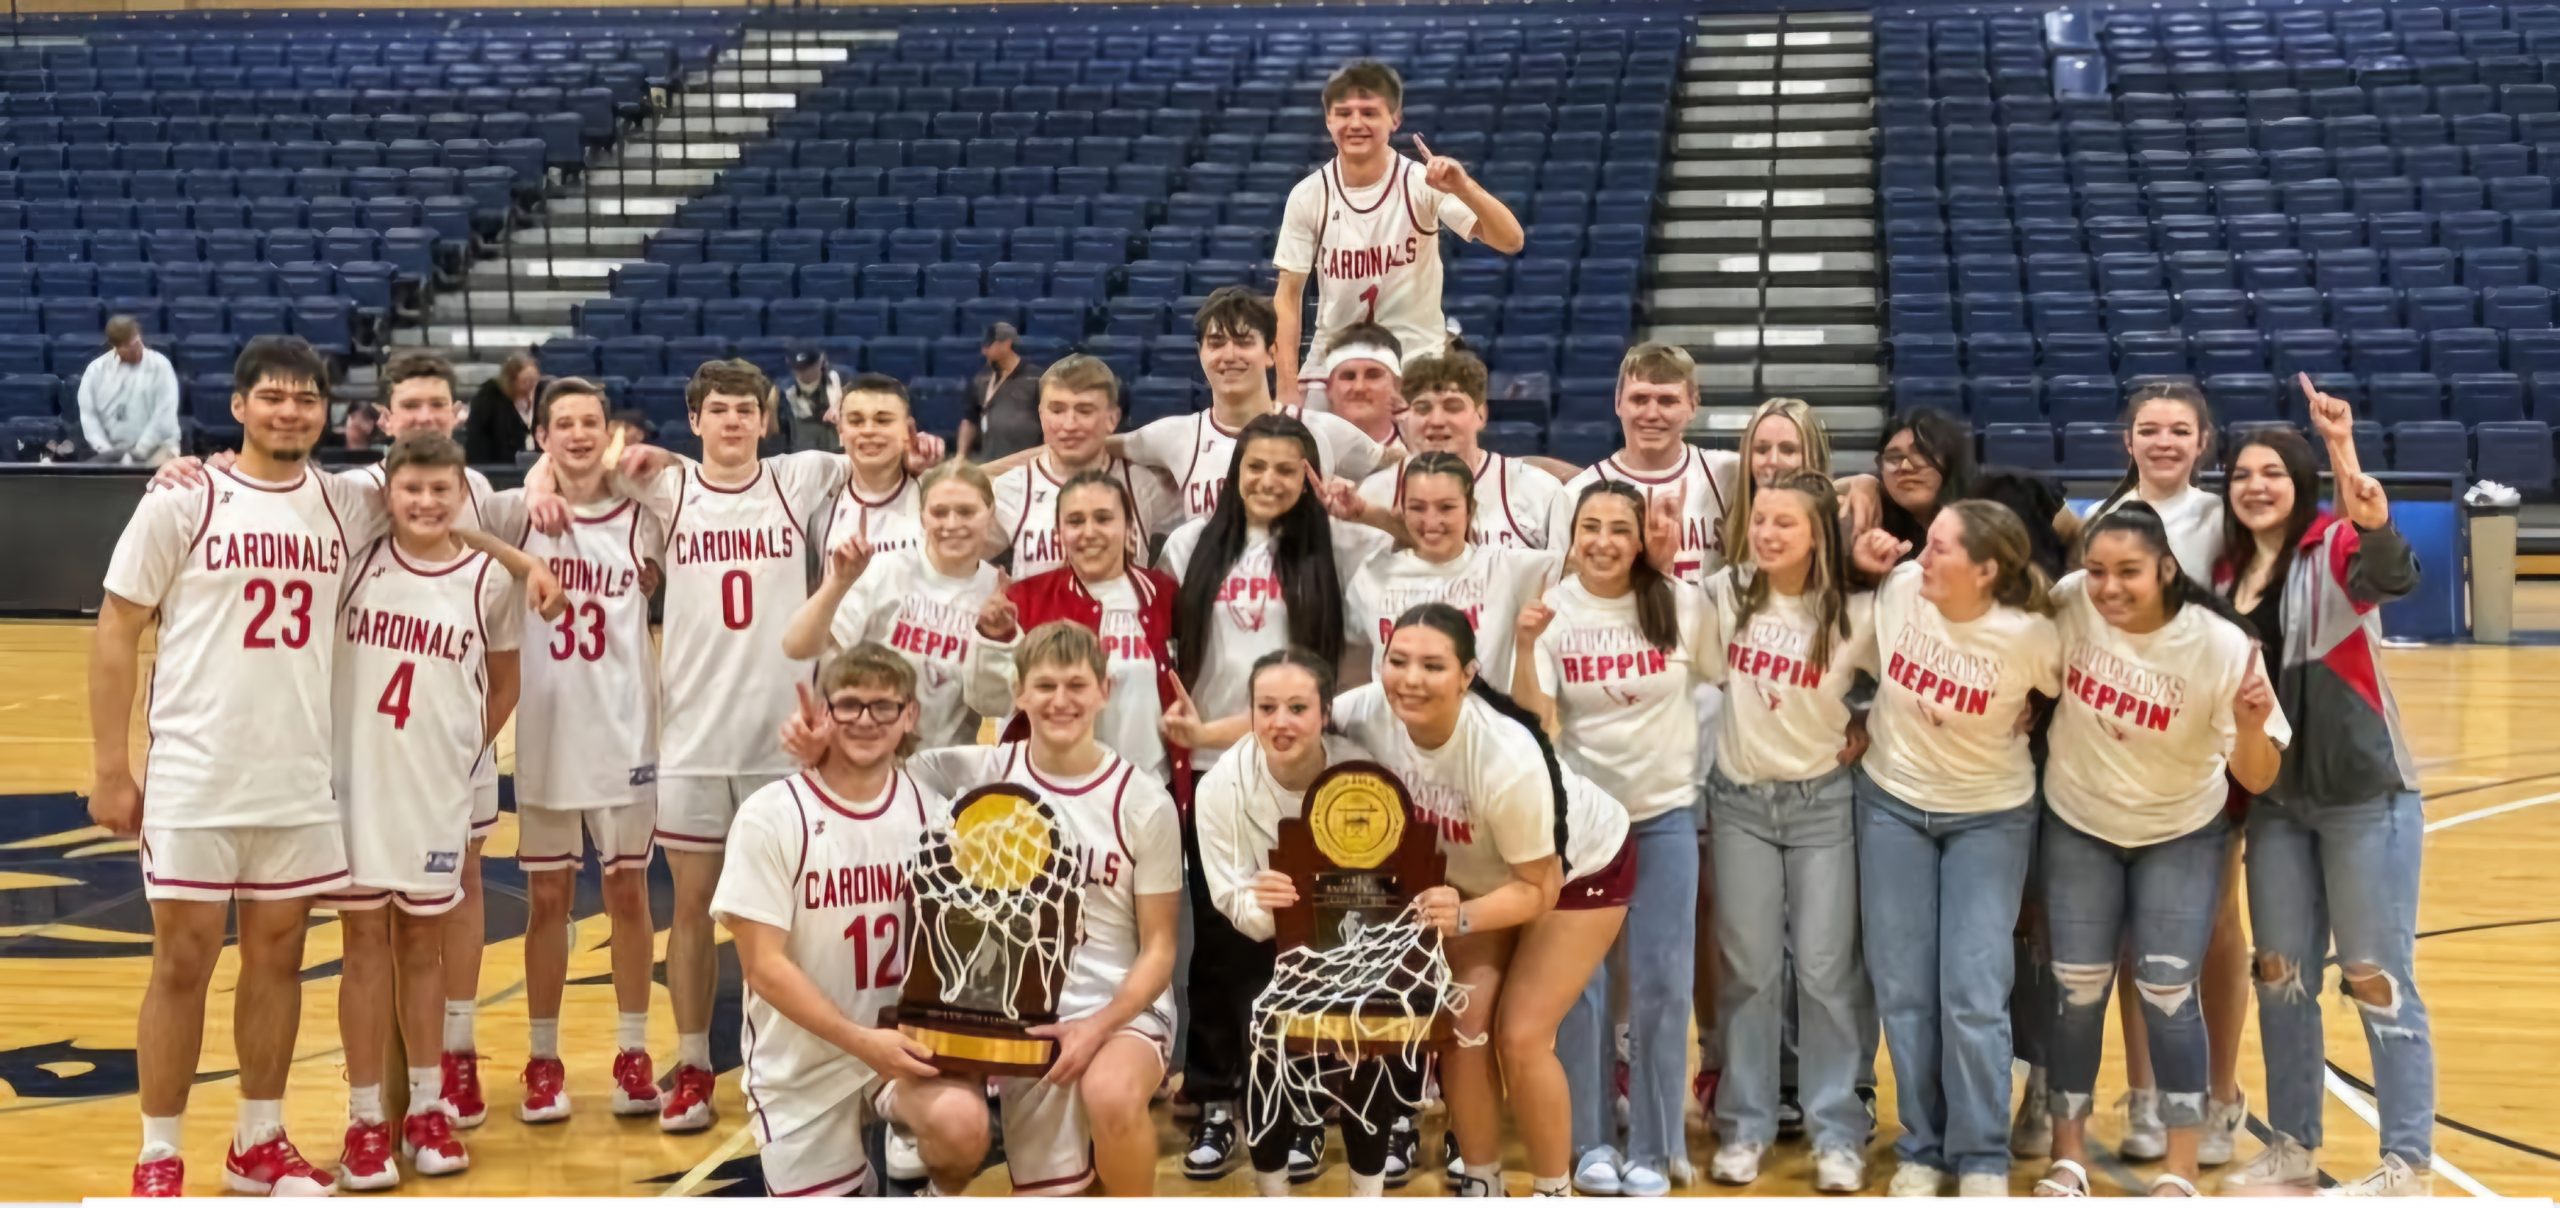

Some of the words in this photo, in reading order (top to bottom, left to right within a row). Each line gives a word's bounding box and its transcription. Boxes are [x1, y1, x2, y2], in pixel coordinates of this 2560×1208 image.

[1359, 283, 1379, 324] 1
[206, 532, 340, 575] CARDINALS
[676, 526, 793, 565] CARDINALS
[243, 578, 313, 649] 23
[721, 569, 753, 631] 0
[346, 606, 474, 663] CARDINALS
[550, 600, 606, 662] 33
[891, 621, 969, 665] REPPI
[1562, 647, 1667, 684] REPPIN
[1728, 642, 1822, 690] REPPIN
[1888, 651, 1996, 716] REPPIN'
[377, 661, 416, 730] 4
[2066, 664, 2180, 732] REPPIN'
[805, 861, 909, 910] CARDINA
[844, 913, 901, 991] 12
